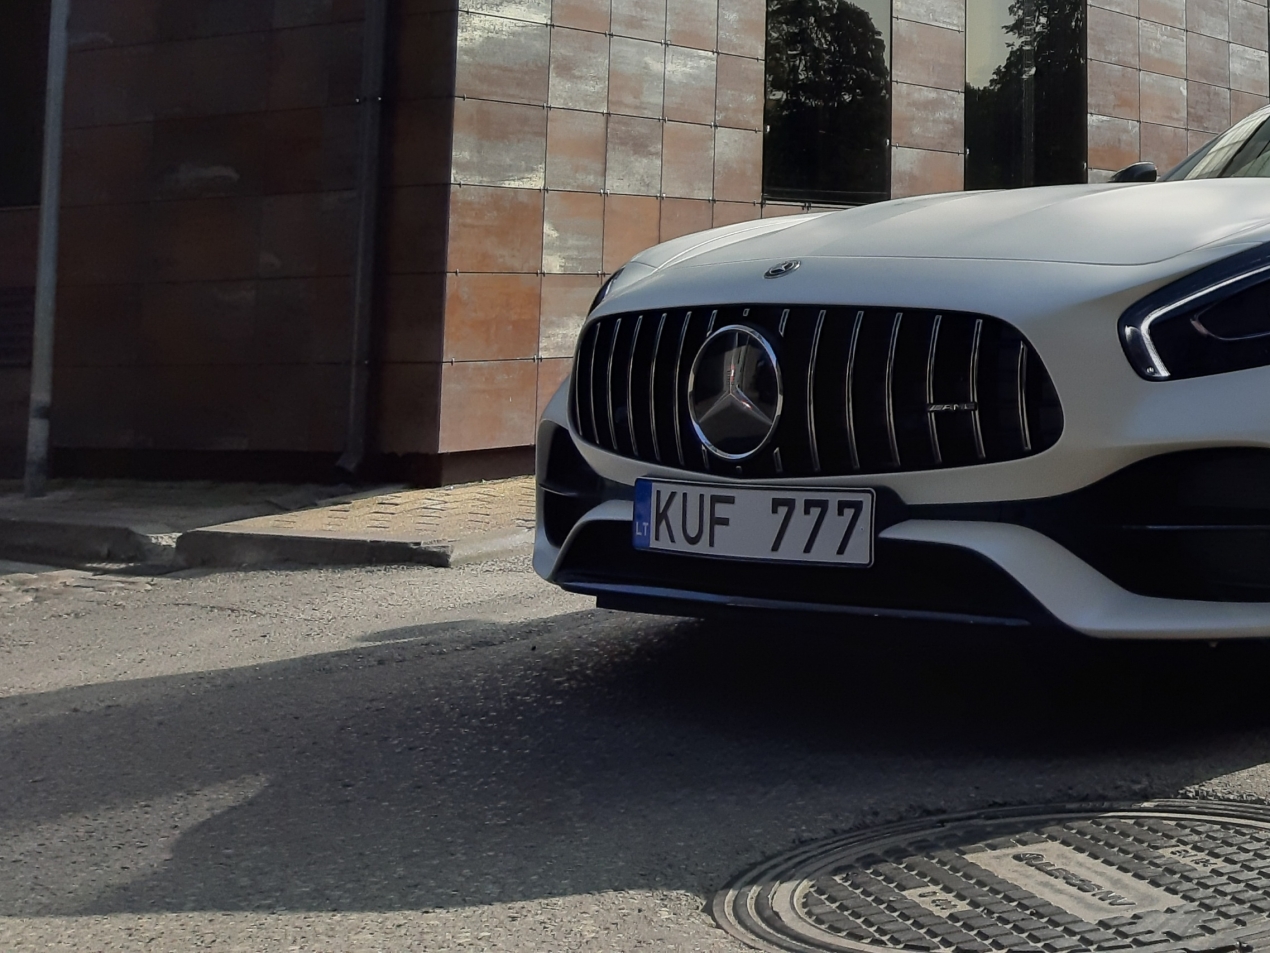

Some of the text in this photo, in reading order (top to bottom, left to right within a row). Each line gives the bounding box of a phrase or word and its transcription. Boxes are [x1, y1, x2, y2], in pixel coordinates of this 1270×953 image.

[635, 522, 648, 536] LT
[654, 489, 864, 555] KUF 777
